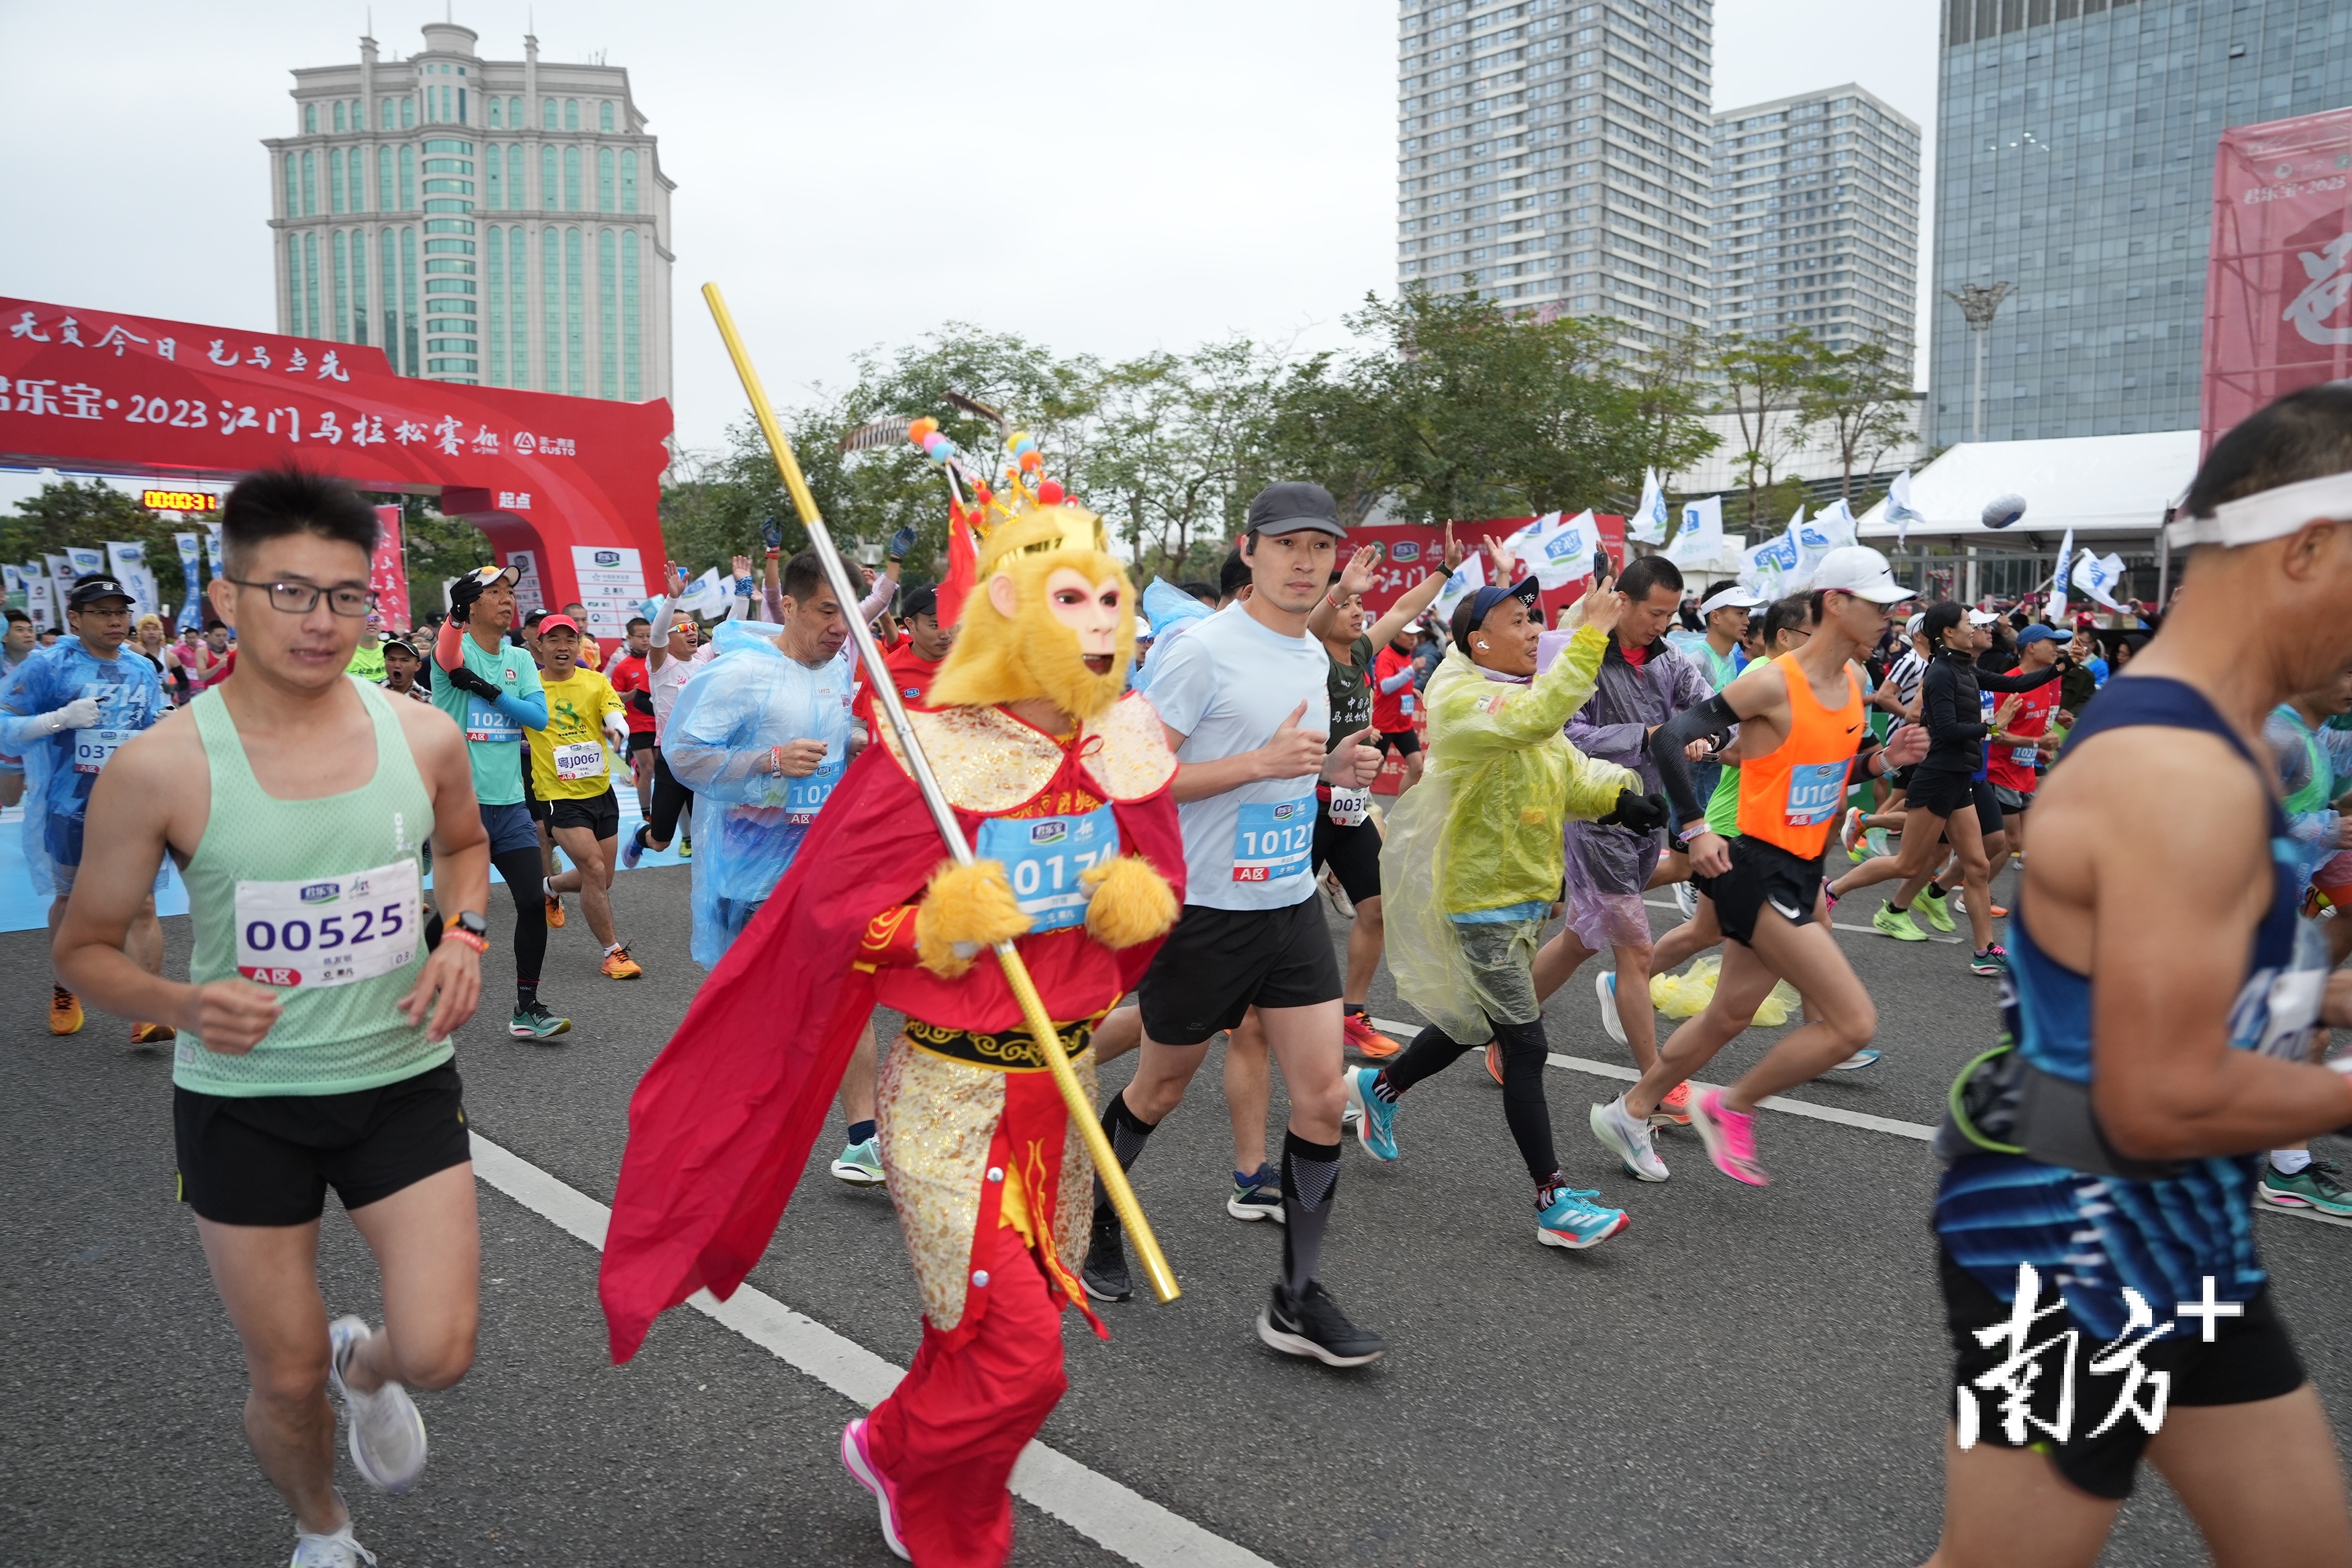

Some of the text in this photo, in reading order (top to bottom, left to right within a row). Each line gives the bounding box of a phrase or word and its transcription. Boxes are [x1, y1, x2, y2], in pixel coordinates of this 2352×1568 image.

[9, 311, 350, 383] 无负今日 邑马当先
[539, 446, 577, 456] GUSTO
[498, 491, 532, 510] 起点
[1379, 565, 1427, 594] 江门
[557, 752, 600, 769] 粤J0067
[560, 773, 576, 781] A区
[791, 814, 810, 824] A区
[1239, 867, 1265, 880] A区
[246, 903, 403, 952] 00525
[252, 968, 293, 986] A区
